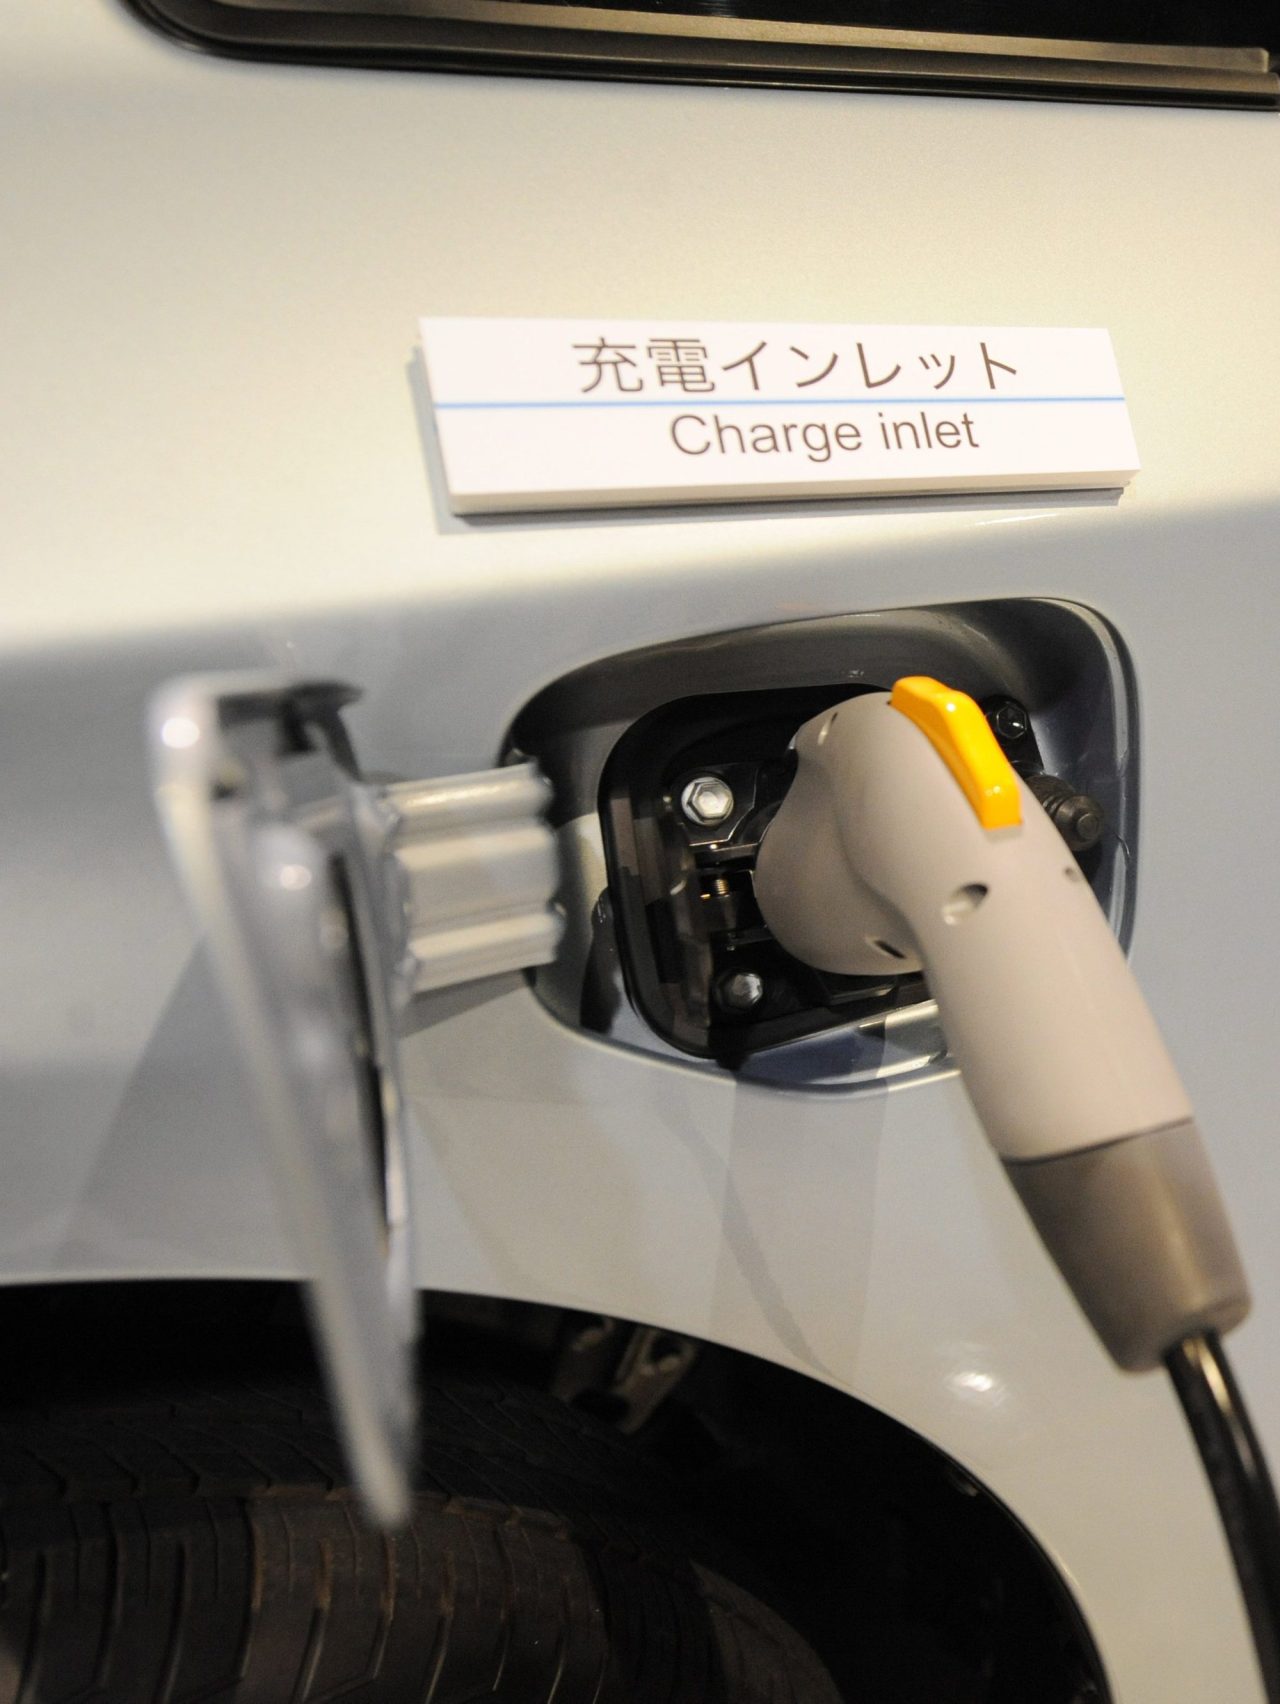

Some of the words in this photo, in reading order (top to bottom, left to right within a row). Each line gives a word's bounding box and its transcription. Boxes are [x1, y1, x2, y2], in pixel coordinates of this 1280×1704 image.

[572, 337, 1017, 393] 充電インレット
[671, 414, 862, 463] Charge
[878, 411, 980, 450] inlet
